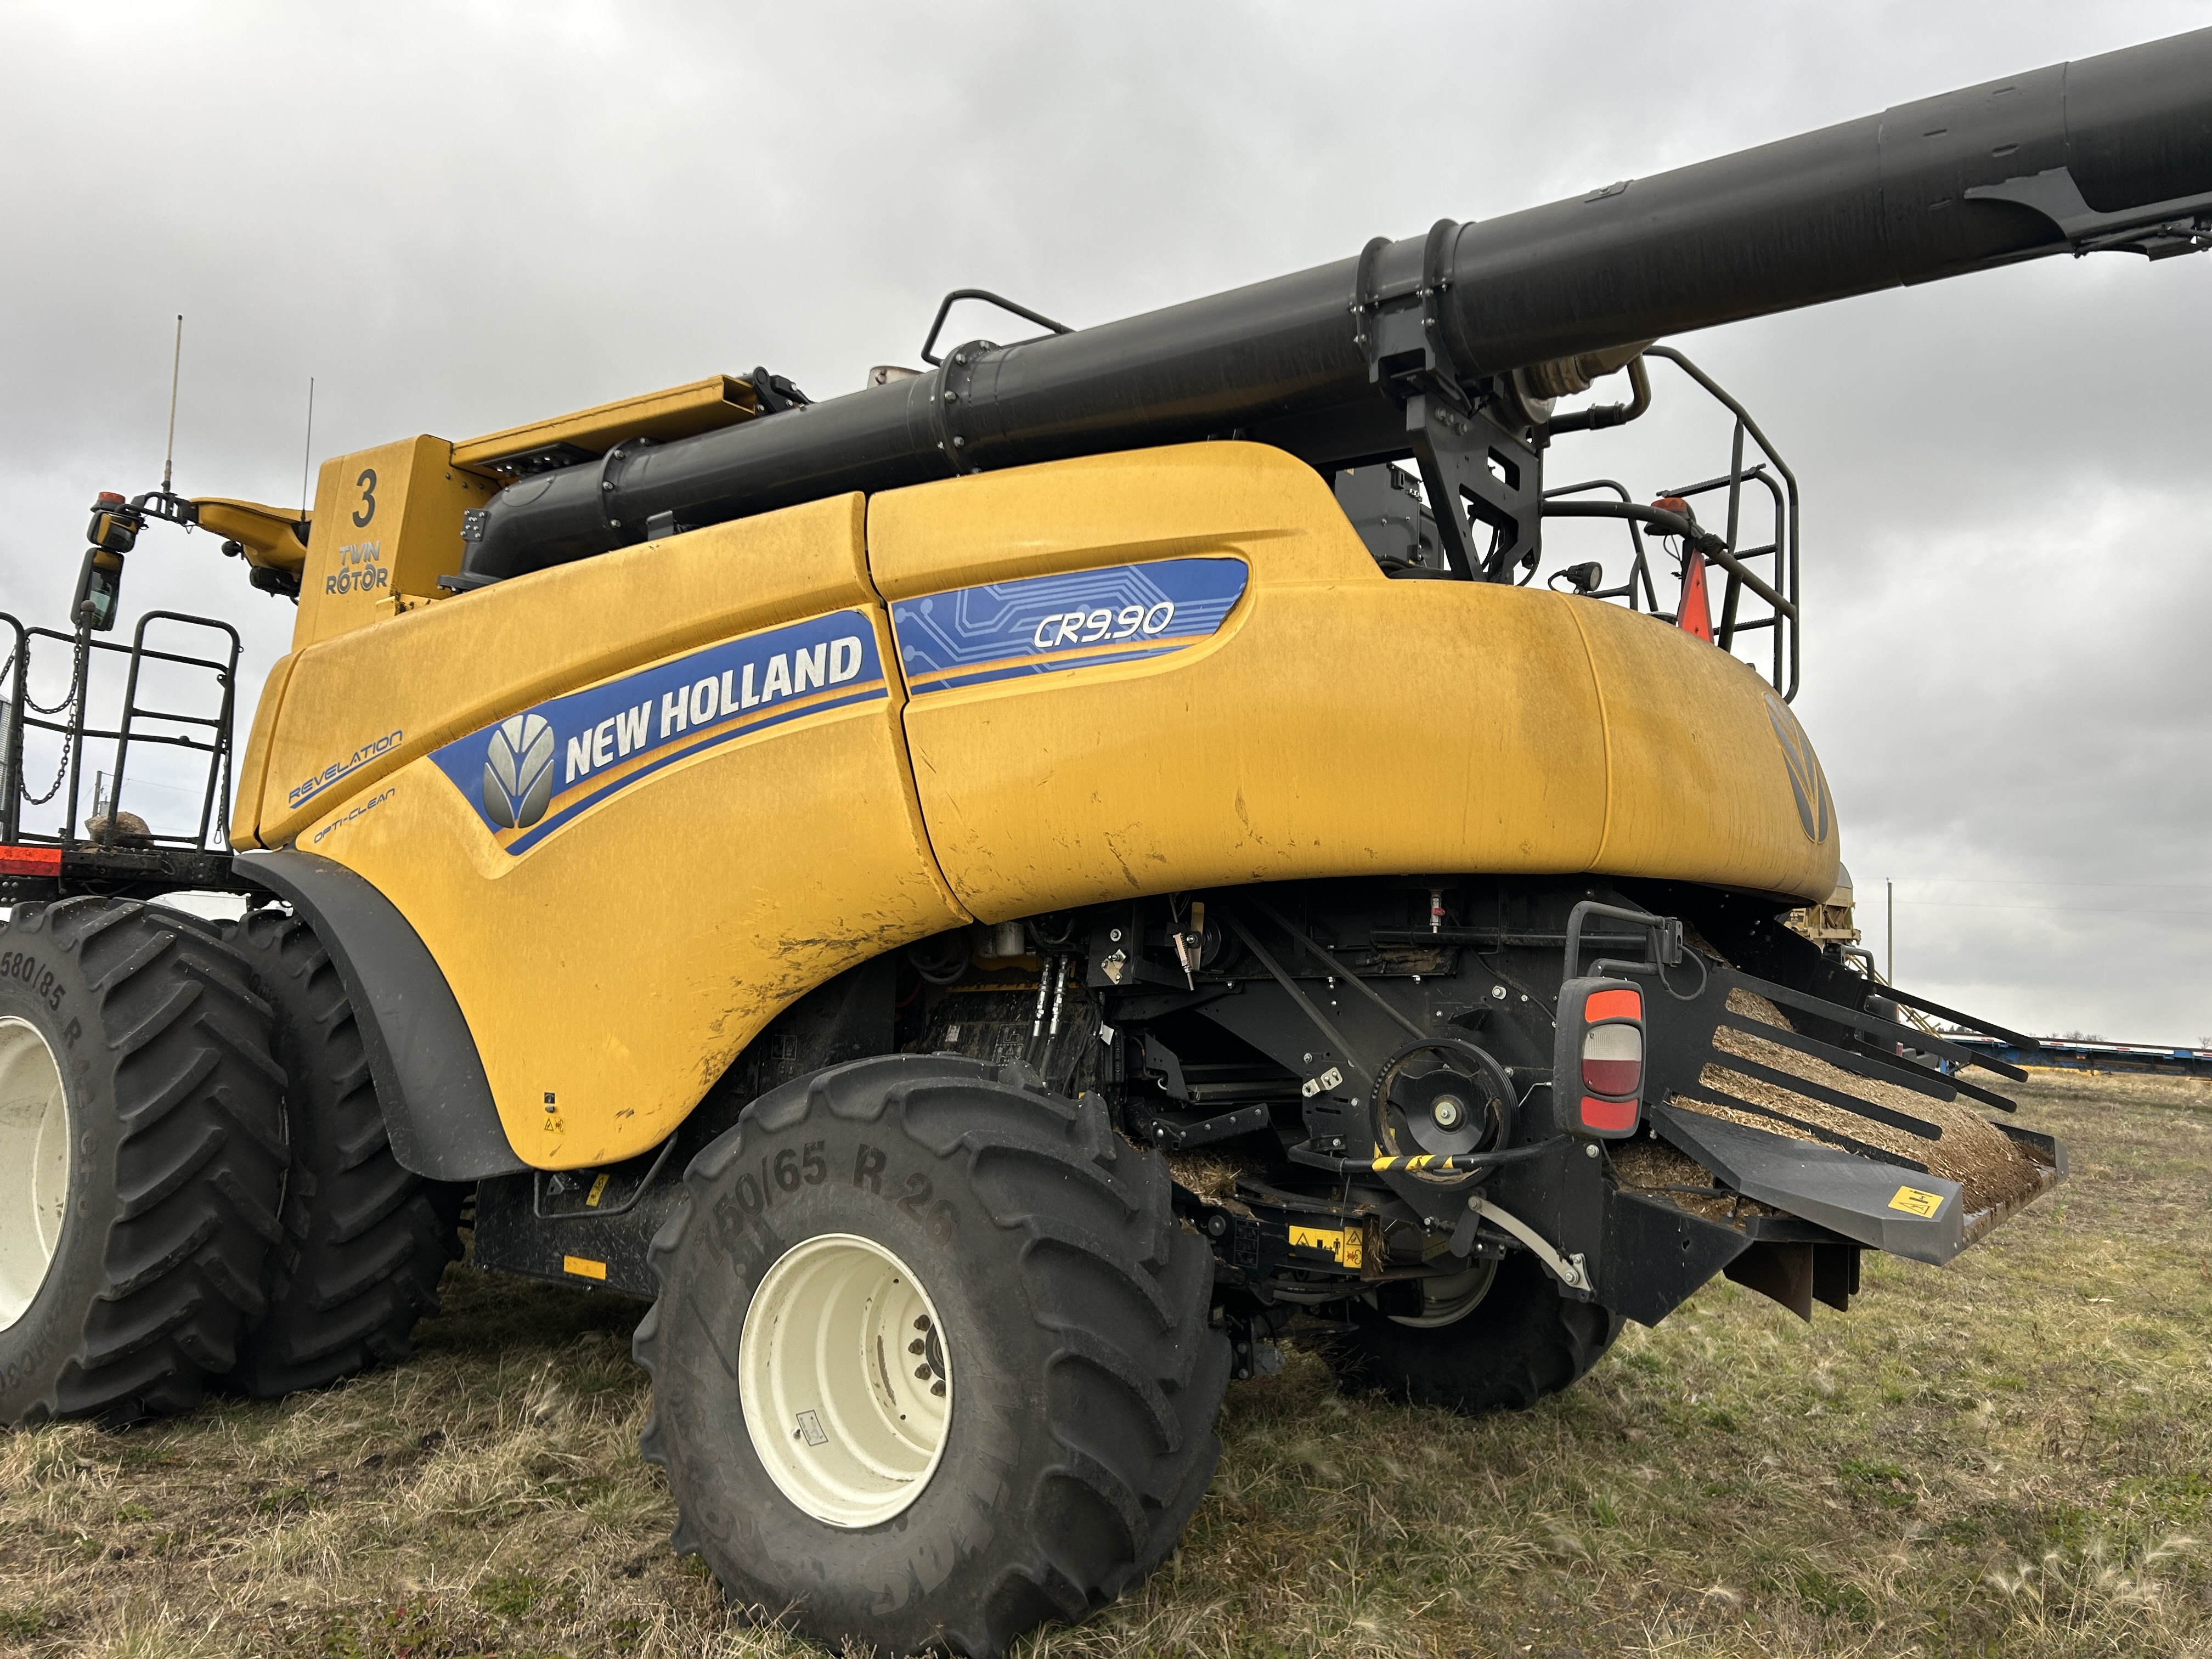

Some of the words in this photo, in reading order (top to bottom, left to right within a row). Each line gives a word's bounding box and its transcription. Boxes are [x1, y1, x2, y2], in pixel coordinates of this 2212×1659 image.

[353, 468, 377, 528] 3
[326, 564, 388, 595] ROTOR
[339, 541, 380, 565] TWIN
[1034, 602, 1175, 648] CR9.90
[565, 700, 653, 785] NEW
[660, 636, 863, 740] HOLLAND
[289, 729, 403, 804] REVELATION
[314, 788, 395, 843] OPTI-CLEAN
[1, 952, 66, 1011] 580/85
[63, 1016, 82, 1050] R
[693, 1140, 827, 1267] 750/65
[853, 1143, 887, 1196] R
[896, 1172, 961, 1246] 26
